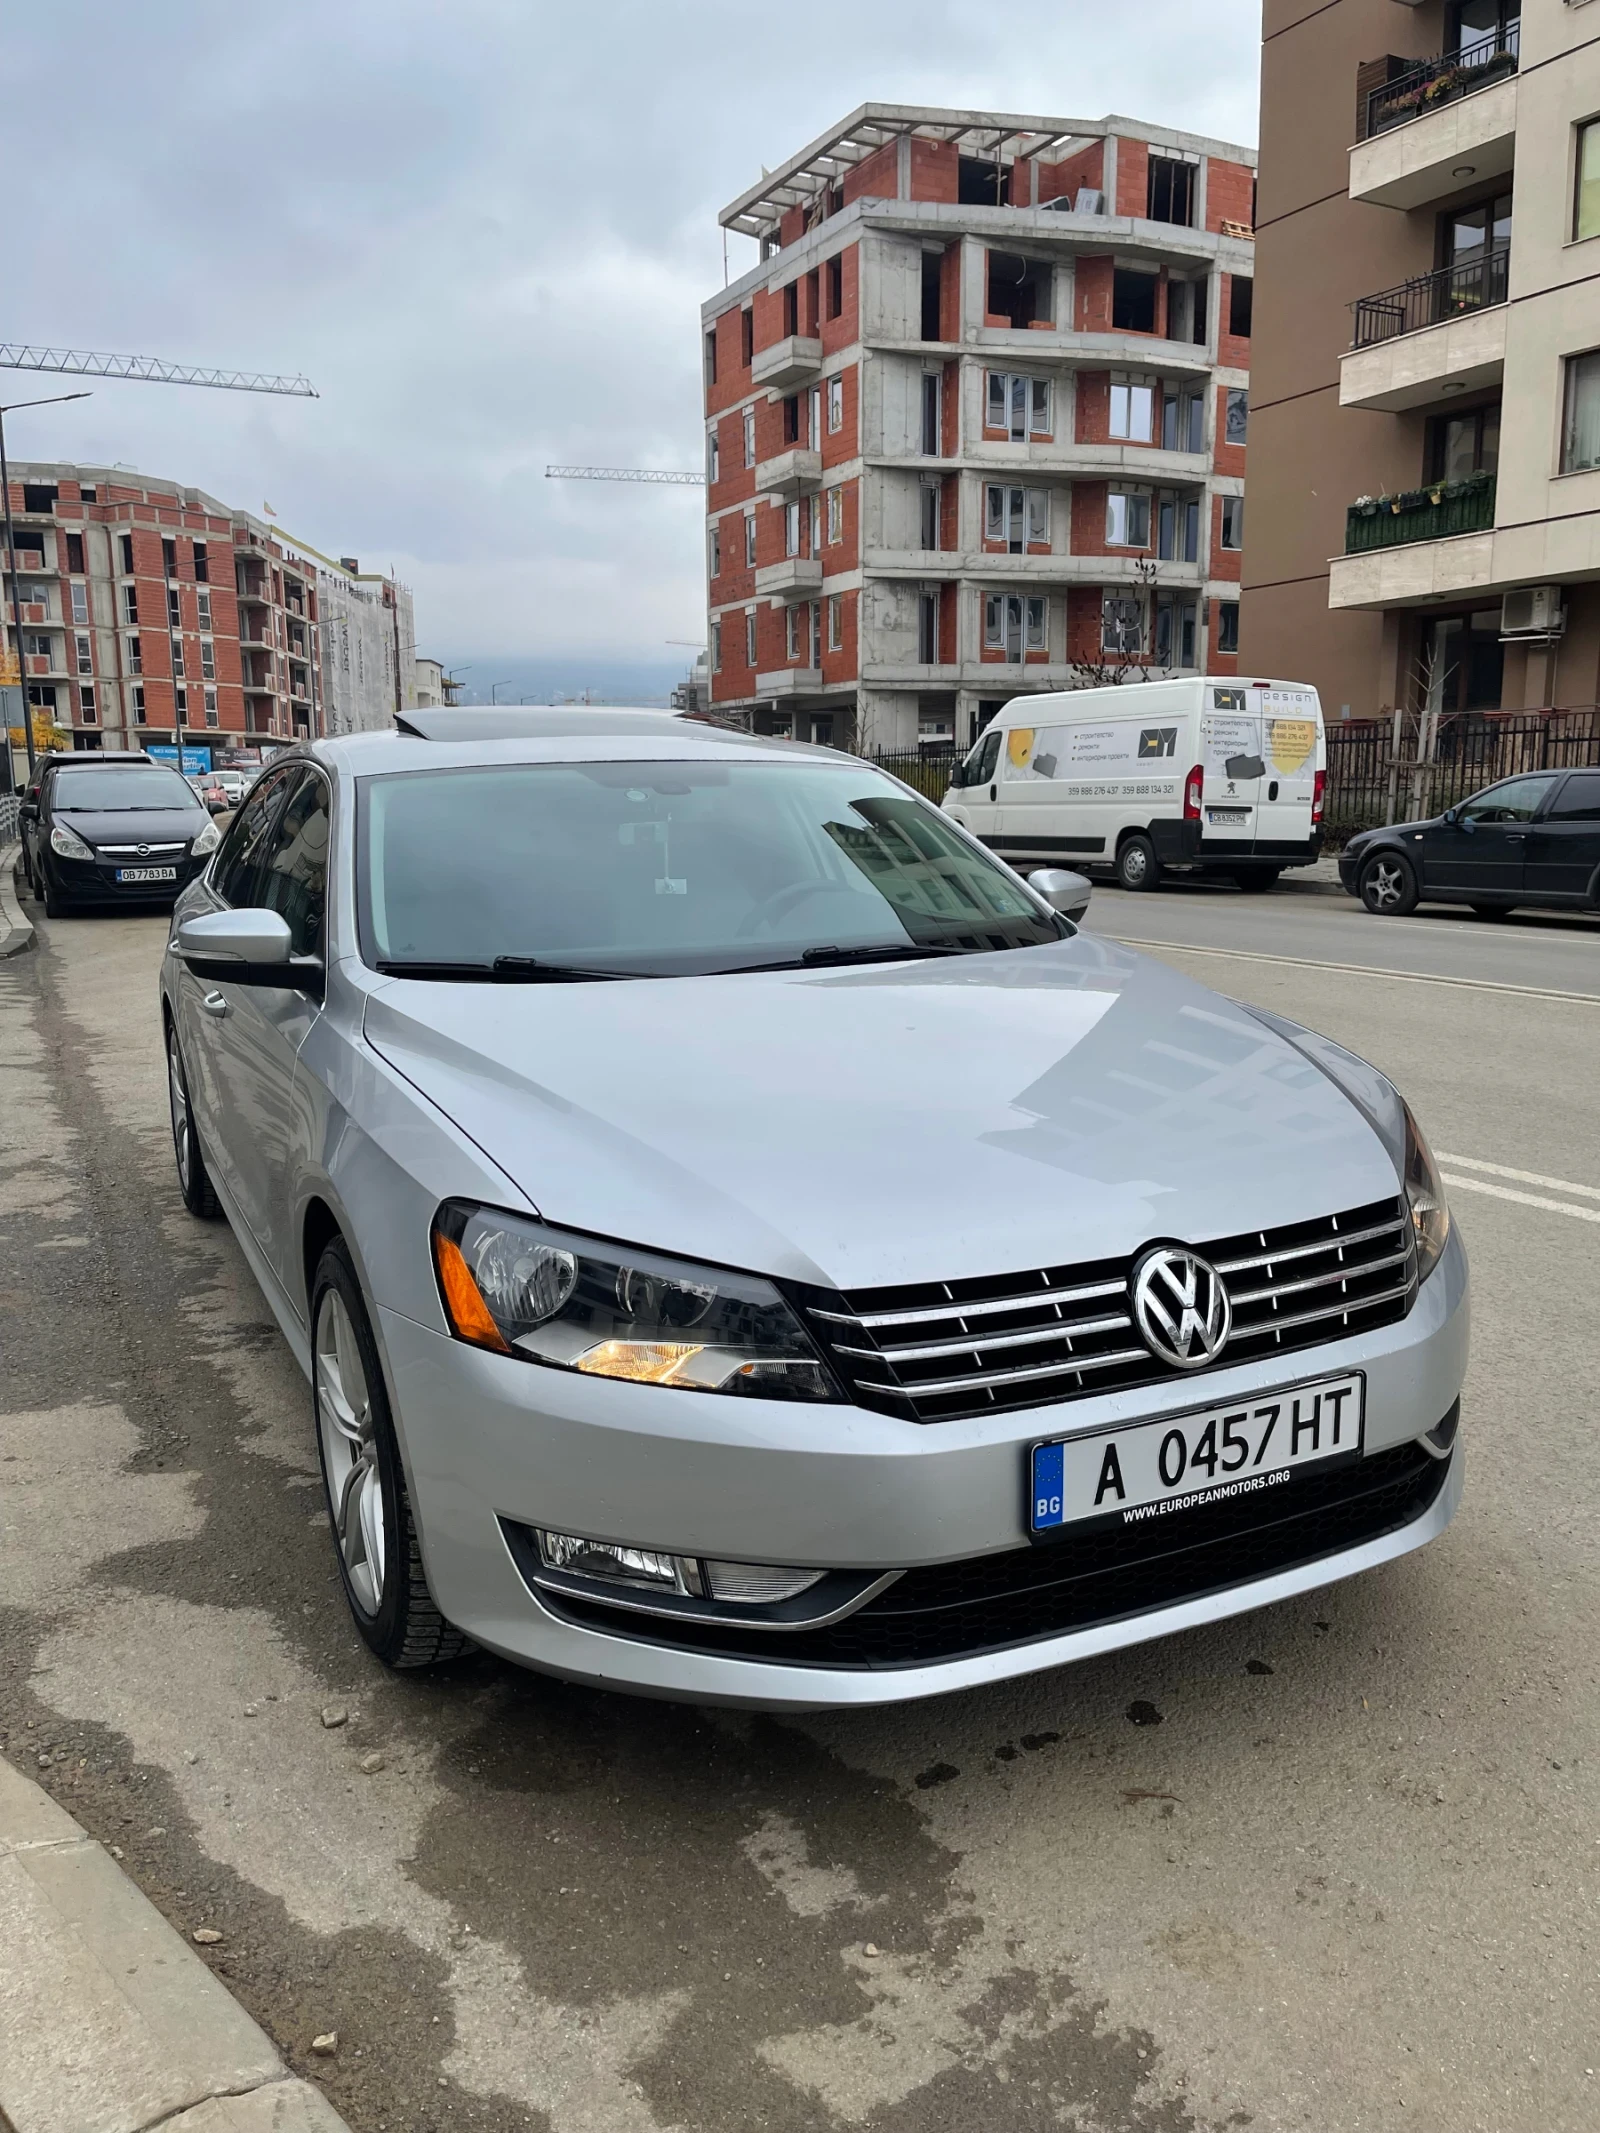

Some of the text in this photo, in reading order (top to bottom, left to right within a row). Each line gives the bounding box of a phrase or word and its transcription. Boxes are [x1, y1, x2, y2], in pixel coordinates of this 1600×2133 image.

[1068, 787, 1079, 795] 359
[1081, 787, 1093, 795] 886
[1094, 787, 1105, 795] 276
[1107, 786, 1119, 795] 437
[1122, 786, 1134, 794] 359
[1151, 785, 1161, 794] 134
[1163, 785, 1174, 793] 321
[123, 869, 174, 880] OB 7783 BA
[1136, 1249, 1229, 1368] VW
[1093, 1386, 1353, 1506] A 0457 HT
[1036, 1496, 1061, 1518] BG
[1122, 1469, 1291, 1524] WWW.EUROPEANMOTORS.ORG
